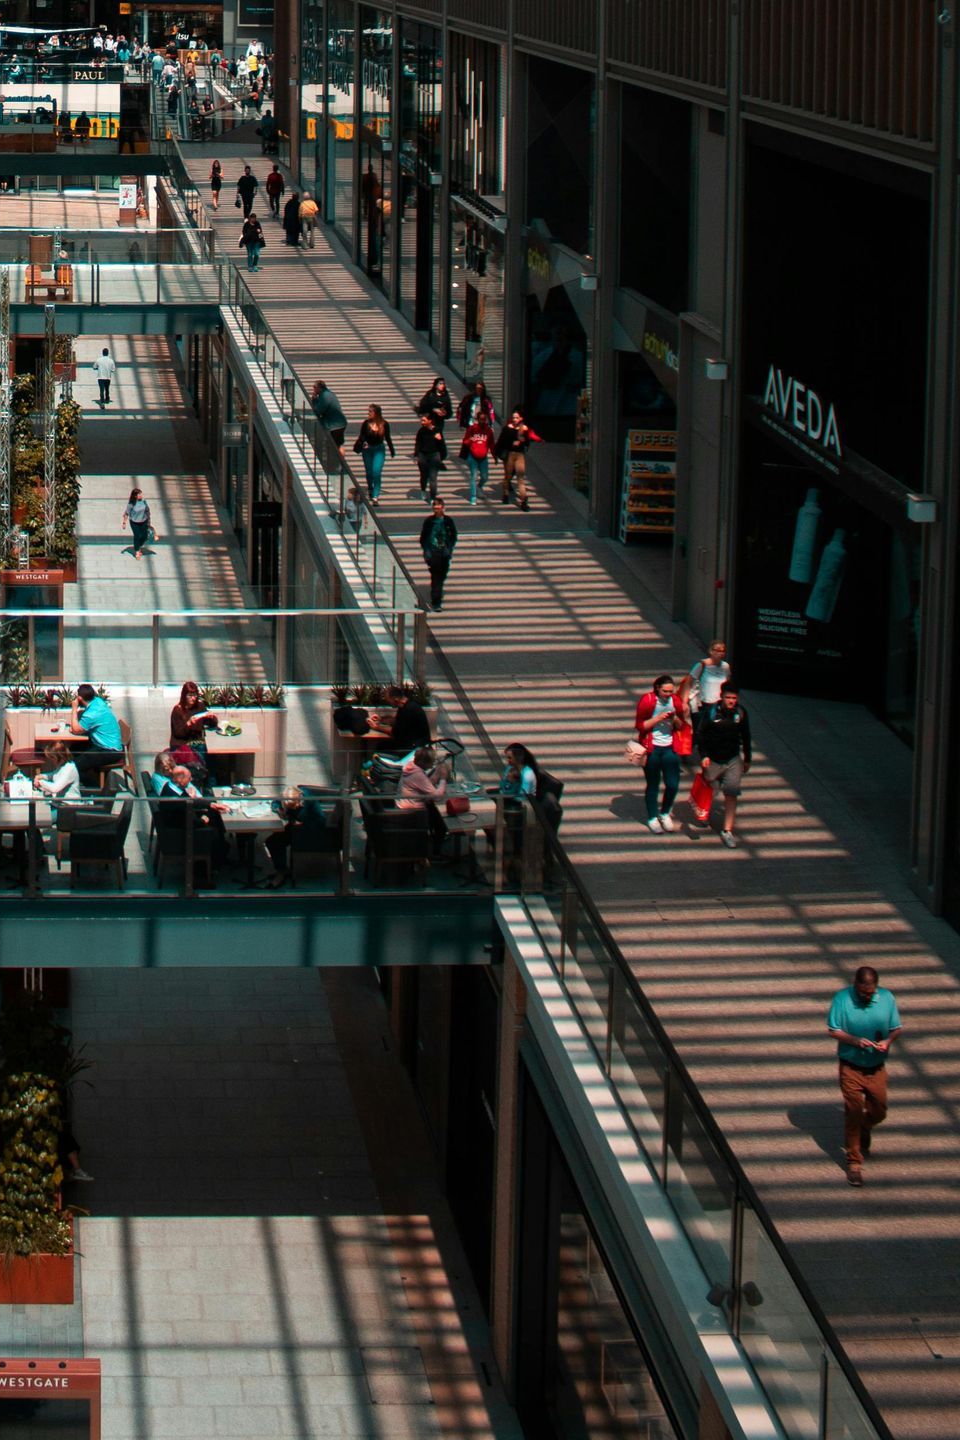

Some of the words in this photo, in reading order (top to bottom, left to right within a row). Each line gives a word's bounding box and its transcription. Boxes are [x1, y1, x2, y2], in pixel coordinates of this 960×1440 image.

[175, 32, 190, 41] itsu
[74, 71, 105, 80] PAUL
[764, 362, 842, 457] AVEDA
